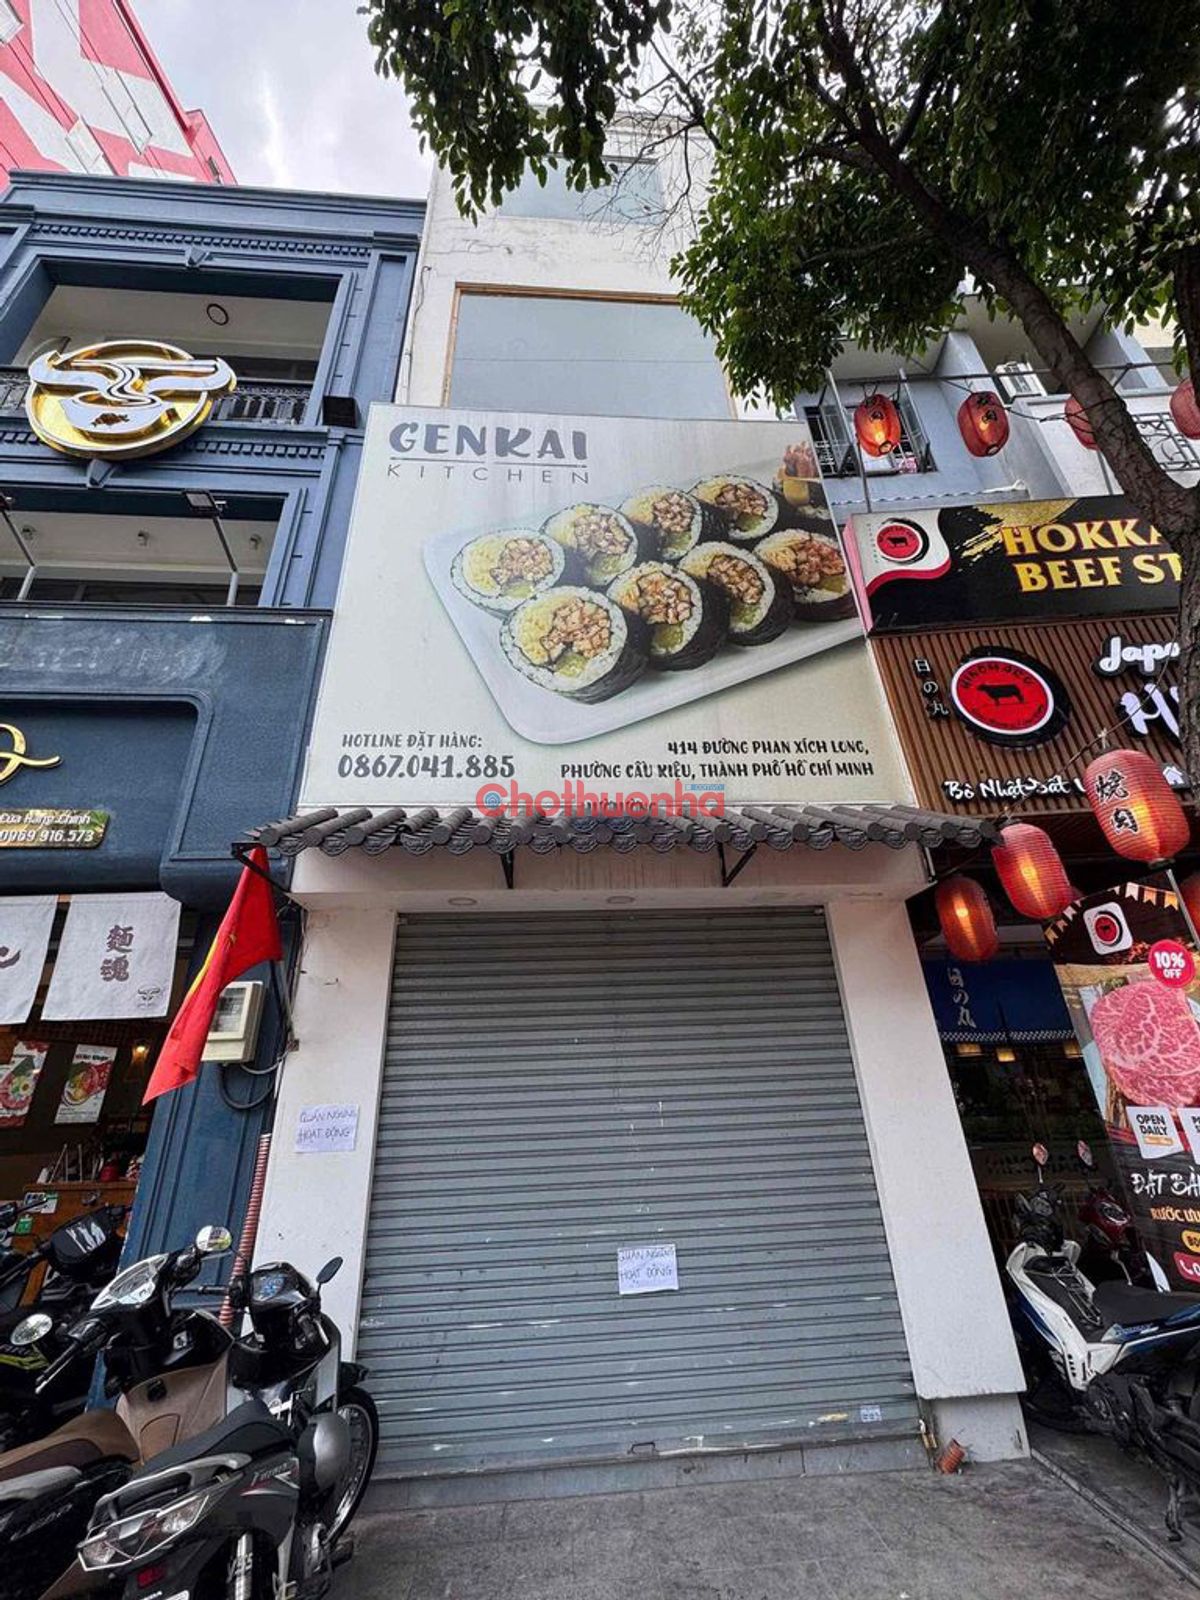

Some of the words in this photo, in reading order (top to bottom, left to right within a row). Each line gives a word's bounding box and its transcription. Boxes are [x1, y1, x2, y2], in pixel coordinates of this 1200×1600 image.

[389, 422, 588, 460] GENKAI
[387, 464, 589, 484] KITCHEN
[1013, 556, 1123, 593] BEEF
[342, 734, 402, 747] HOTLINE
[406, 730, 436, 751] ĐẶT
[440, 732, 482, 748] HÀNG:
[667, 741, 697, 754] 414
[702, 738, 748, 754] ĐƯỜNG
[752, 740, 791, 754] PHAN
[794, 738, 828, 753] XÍCH
[832, 740, 869, 756] LONG,
[338, 754, 515, 778] 0867.041.885
[560, 761, 621, 778] PHƯỜNG
[699, 761, 748, 778] THÀNH
[752, 759, 786, 777] PHỐ
[787, 759, 808, 777] HỒ
[810, 759, 833, 776] CHÍ
[835, 762, 874, 777] MINH
[39, 829, 95, 842] 916.573
[1154, 952, 1185, 968] 10%
[1163, 969, 1182, 979] OFF
[1136, 1113, 1166, 1126] OPEN
[1140, 1125, 1169, 1137] DAILY
[1170, 1165, 1200, 1197] BÀ
